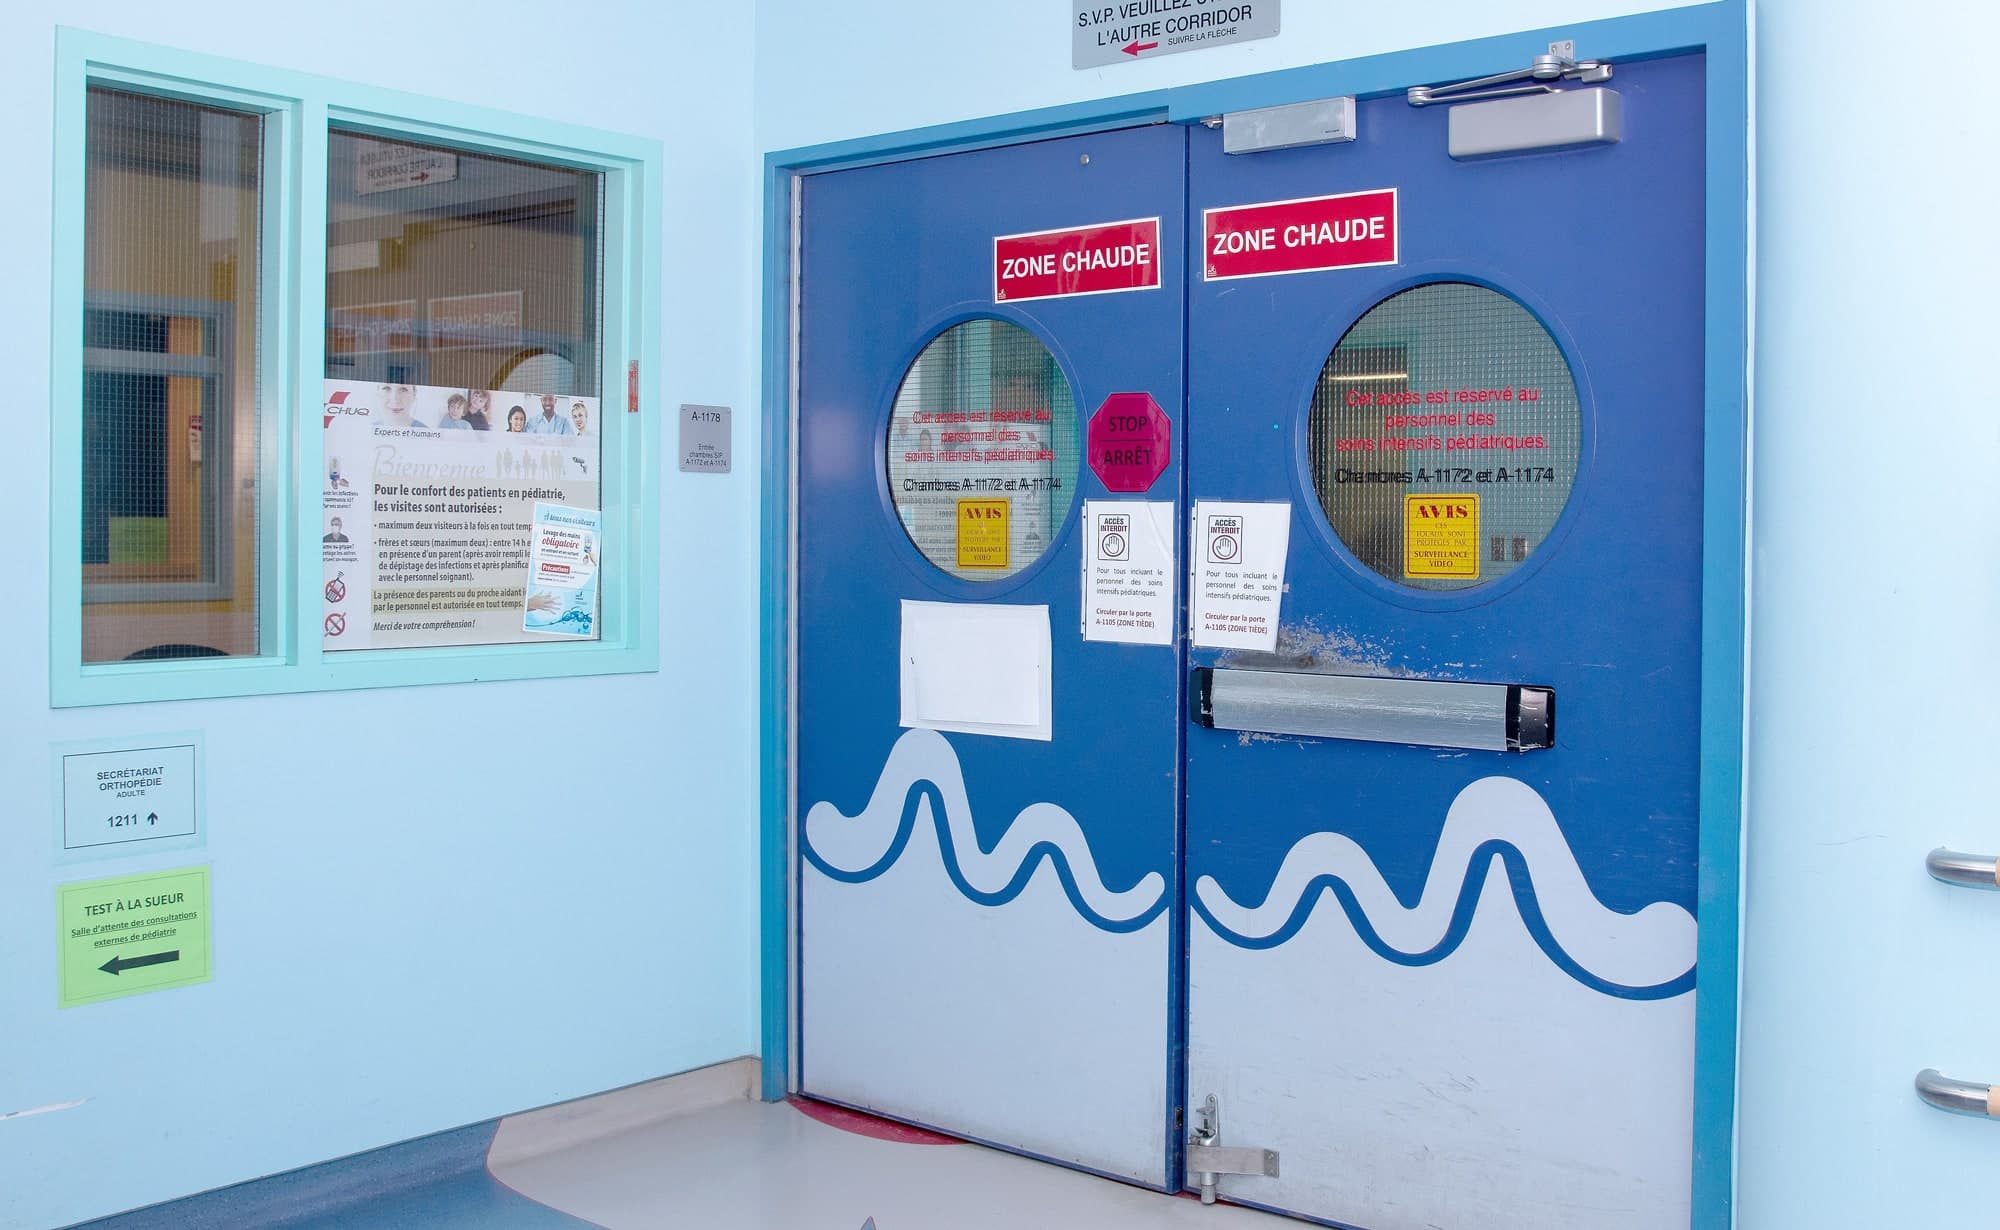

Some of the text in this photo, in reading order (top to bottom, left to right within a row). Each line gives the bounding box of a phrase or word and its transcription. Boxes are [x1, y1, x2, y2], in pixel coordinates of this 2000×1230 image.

[1078, 7, 1114, 27] S.V.P.
[1098, 5, 1252, 46] L'AUTRE CORRIDOR
[1168, 26, 1238, 46] SUIVRE LA FLÈCHE
[1213, 216, 1386, 255] ZONE CHAUDE
[1002, 243, 1150, 279] ZONE CHAUDE
[1346, 386, 1539, 406] Cet accès est réservé au
[327, 406, 370, 416] CHUQ
[692, 411, 720, 422] A-1178
[970, 410, 986, 422] est
[1035, 410, 1052, 421] au
[1108, 416, 1148, 432] STOP
[1386, 410, 1495, 431] personnel des
[374, 428, 440, 438] Experts humains
[940, 428, 1021, 444] personnel des
[1336, 432, 1549, 452] soins intensifs pédiatriques.
[1102, 444, 1152, 466] ARRÊT
[373, 444, 486, 479] Bienvenue
[1335, 466, 1554, 484] Chambres A-1172 et A-1174
[374, 484, 566, 500] Pour le confort des patients en pédiatrie,
[374, 500, 496, 514] les visites sont autorisées
[964, 507, 1002, 519] AVIS
[1416, 504, 1468, 518] AVIS
[378, 521, 414, 530] maximum
[416, 521, 432, 530] deux
[434, 522, 462, 530] visiteurs
[478, 522, 490, 530] fois
[500, 523, 514, 531] tout
[1214, 518, 1236, 526] ACCÈS
[378, 538, 399, 546] frères
[432, 538, 468, 548] (maximum
[542, 537, 579, 548] obligatoire
[390, 550, 420, 560] présence
[422, 550, 438, 558] d'un
[438, 551, 462, 560] parent
[462, 550, 484, 560] (après
[502, 550, 524, 559] rempli
[378, 560, 528, 571] de dépistage des infections après planifica
[404, 573, 438, 583] personnel
[440, 572, 474, 582] soignant).
[1206, 582, 1236, 590] personnel
[374, 590, 382, 600] La
[384, 590, 415, 600] présence
[416, 590, 428, 599] des
[430, 590, 456, 600] parents
[467, 589, 476, 598] du
[477, 588, 498, 598] proche
[500, 588, 522, 597] aidant
[1120, 588, 1156, 598] pédiatriques.
[1206, 592, 1272, 602] intensifs pédiatriques.
[374, 603, 385, 612] par
[387, 602, 394, 611] le
[396, 602, 430, 612] personnel
[443, 601, 474, 609] autorisée
[502, 601, 524, 610] temps.
[1096, 608, 1152, 618] Circuler par porte
[1205, 612, 1266, 624] Circuler par porte
[374, 622, 393, 630] Merci
[394, 622, 402, 630] de
[1228, 624, 1247, 633] (ZONE
[1249, 625, 1268, 636] TIÈDE)
[97, 766, 164, 780] SECRÉTARIAT
[100, 778, 162, 790] ORTHOPÉDIE
[116, 790, 146, 798] ADULTE
[108, 814, 138, 828] 1211
[85, 892, 184, 916] TEST À LA SUEUR
[72, 911, 198, 937] Salle d'attente des consultations
[94, 928, 176, 948] externes de pédiatrie
